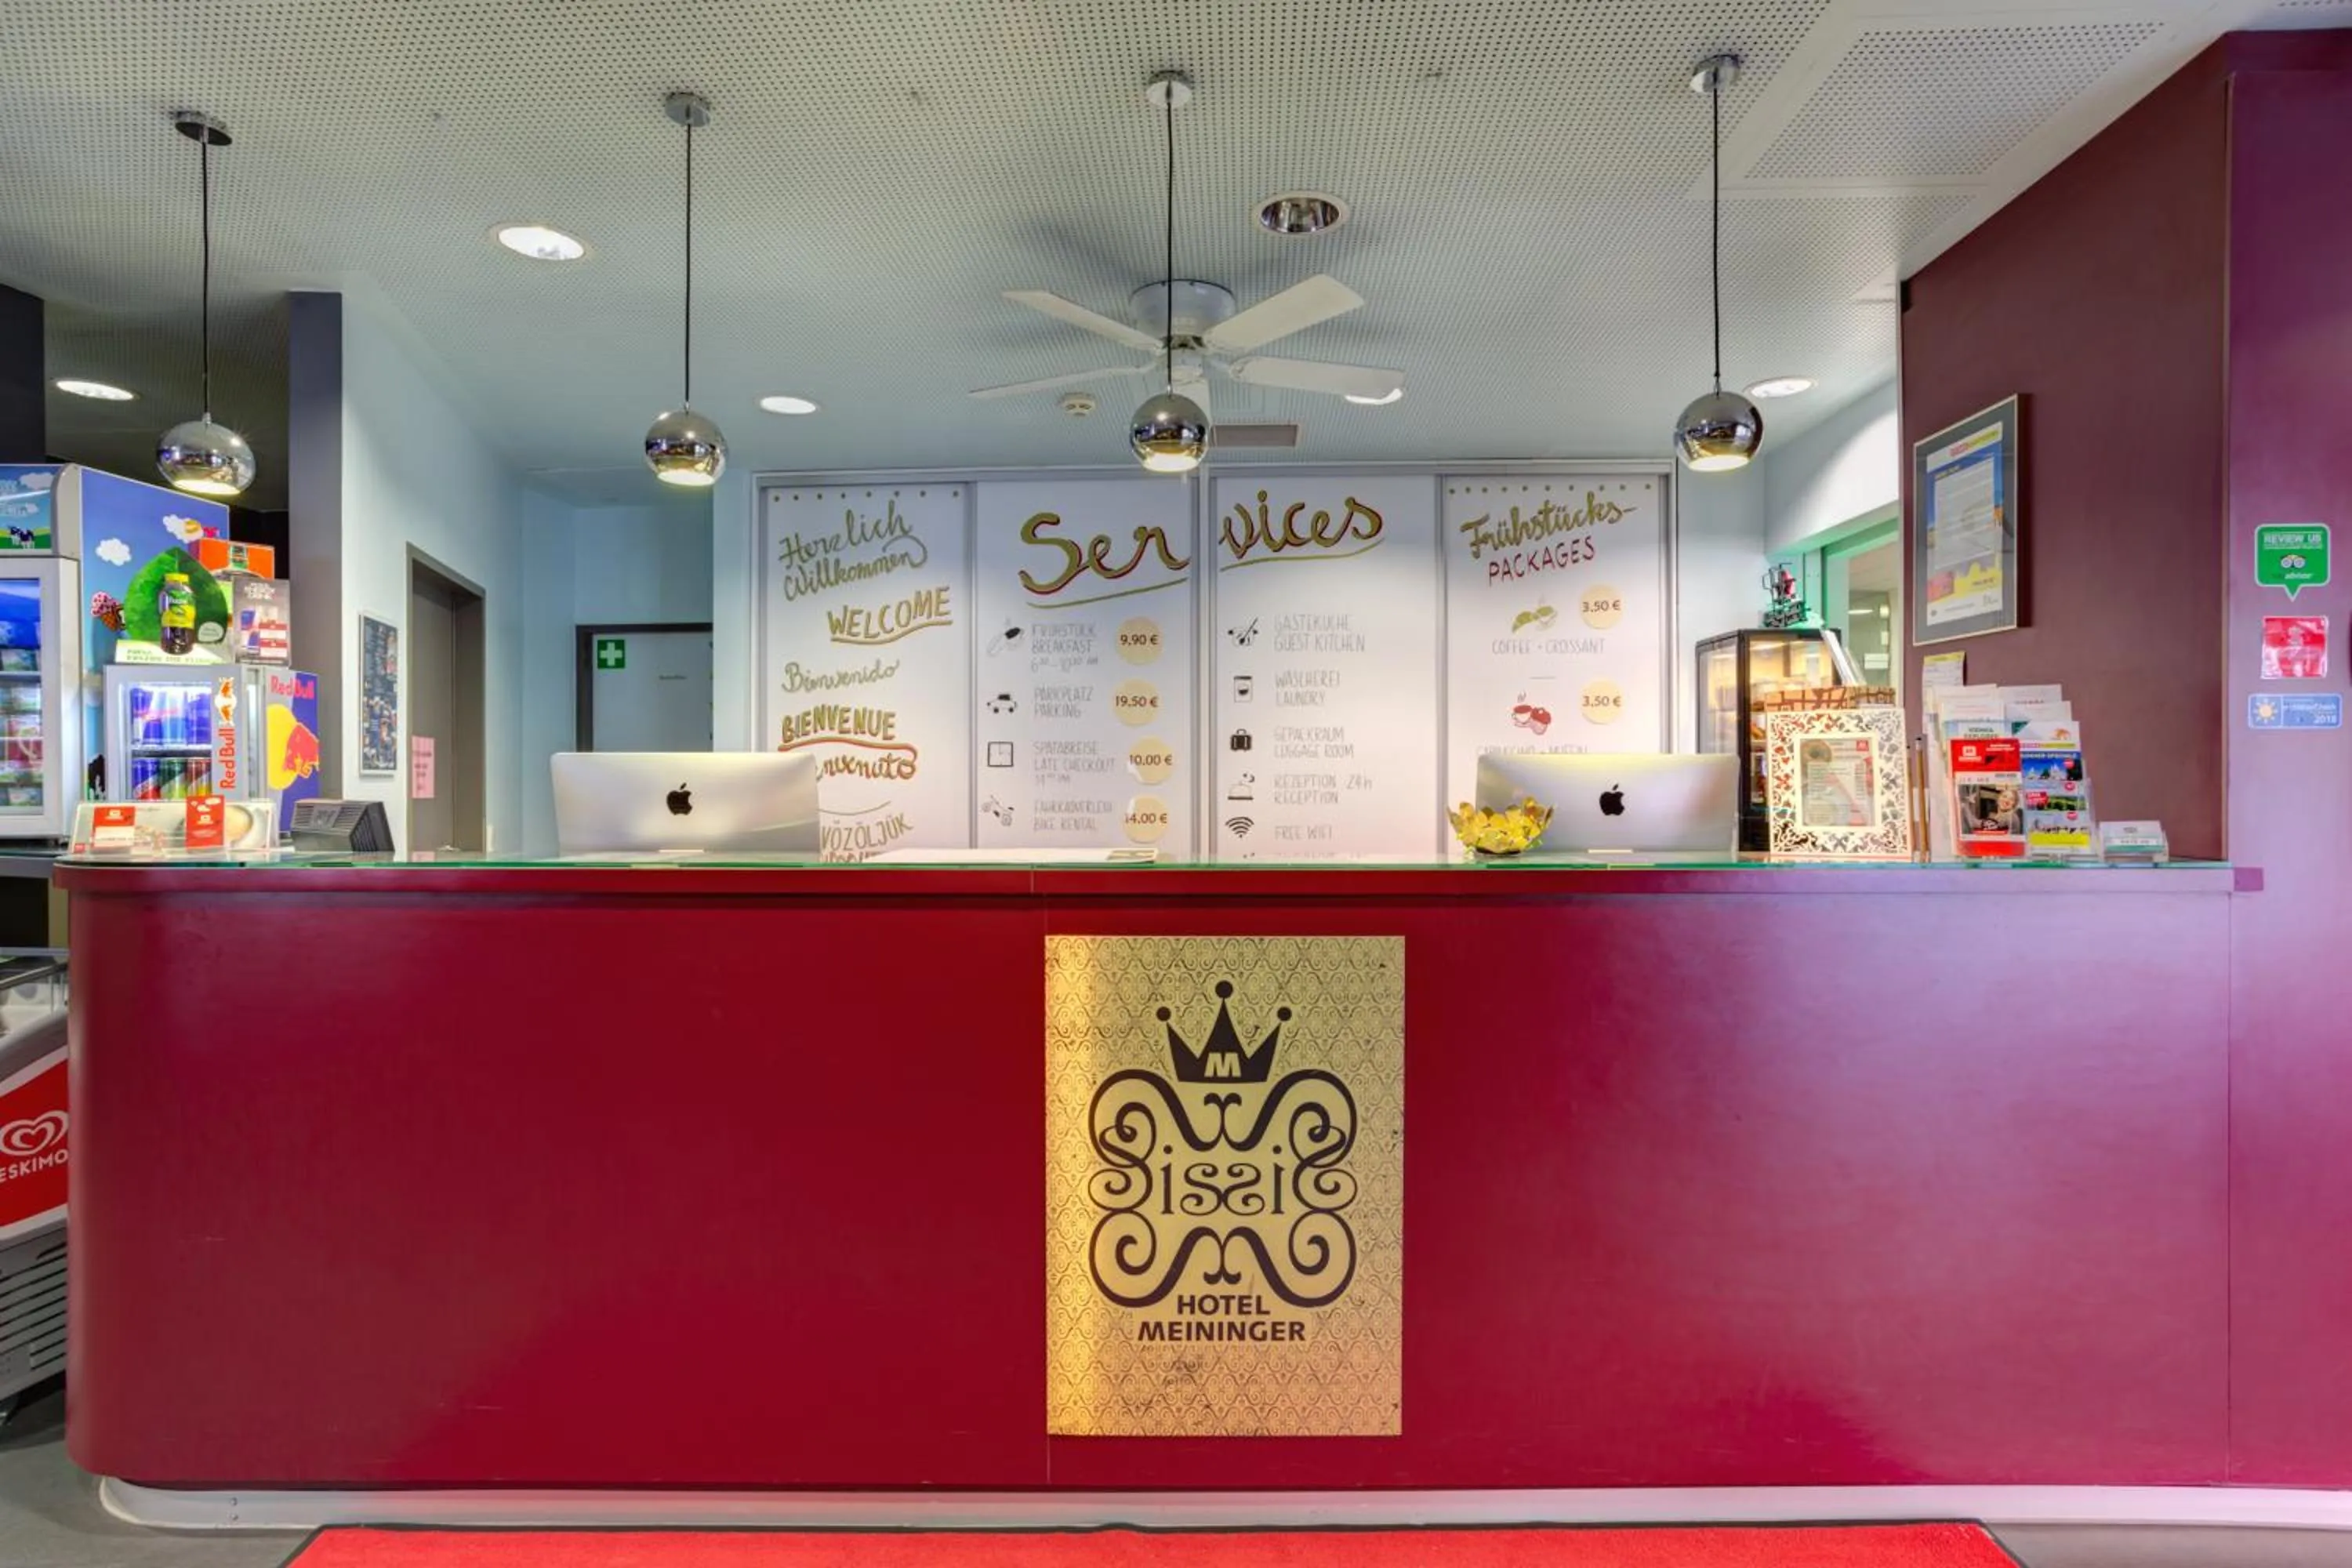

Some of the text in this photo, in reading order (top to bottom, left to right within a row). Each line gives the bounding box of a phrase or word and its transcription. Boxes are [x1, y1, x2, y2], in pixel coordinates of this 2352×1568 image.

[778, 499, 913, 570] Herzlich
[1018, 489, 1383, 595] Ser vices
[784, 535, 927, 601] Willkommen
[1488, 535, 1595, 586] PACKAGES
[827, 586, 951, 640] WELCOME
[1612, 600, 1621, 612] €
[1031, 638, 1092, 655] BREAKFAST
[1150, 634, 1160, 645] €
[1274, 633, 1365, 652] GUEST KITCHEN
[1491, 639, 1530, 655] COFFEE
[1545, 638, 1606, 655] CROISSANT
[782, 659, 900, 693] Bienvenido
[270, 676, 314, 699] Red Bull
[1034, 686, 1094, 702] PARKPLATZ
[1149, 696, 1159, 707] €
[1276, 690, 1326, 706] LAUNDRY
[1612, 695, 1621, 706] €
[1034, 702, 1081, 719] PARKING
[782, 703, 895, 743] BIENVENUE
[219, 727, 235, 790] Red Bull
[1275, 744, 1355, 759] LUGGAGE ROOM
[1034, 757, 1115, 772] LATE CHECKOUT
[1164, 755, 1173, 766] €
[1274, 790, 1339, 804] RECEPTION
[1034, 816, 1098, 831] BIKE RENTAL
[1160, 813, 1167, 824] €
[1275, 826, 1301, 840] FREE
[1204, 1052, 1242, 1078] M
[0, 1149, 68, 1183] ESKIMO
[1177, 1294, 1269, 1315] HOTEL
[1138, 1321, 1305, 1342] MEININGER
